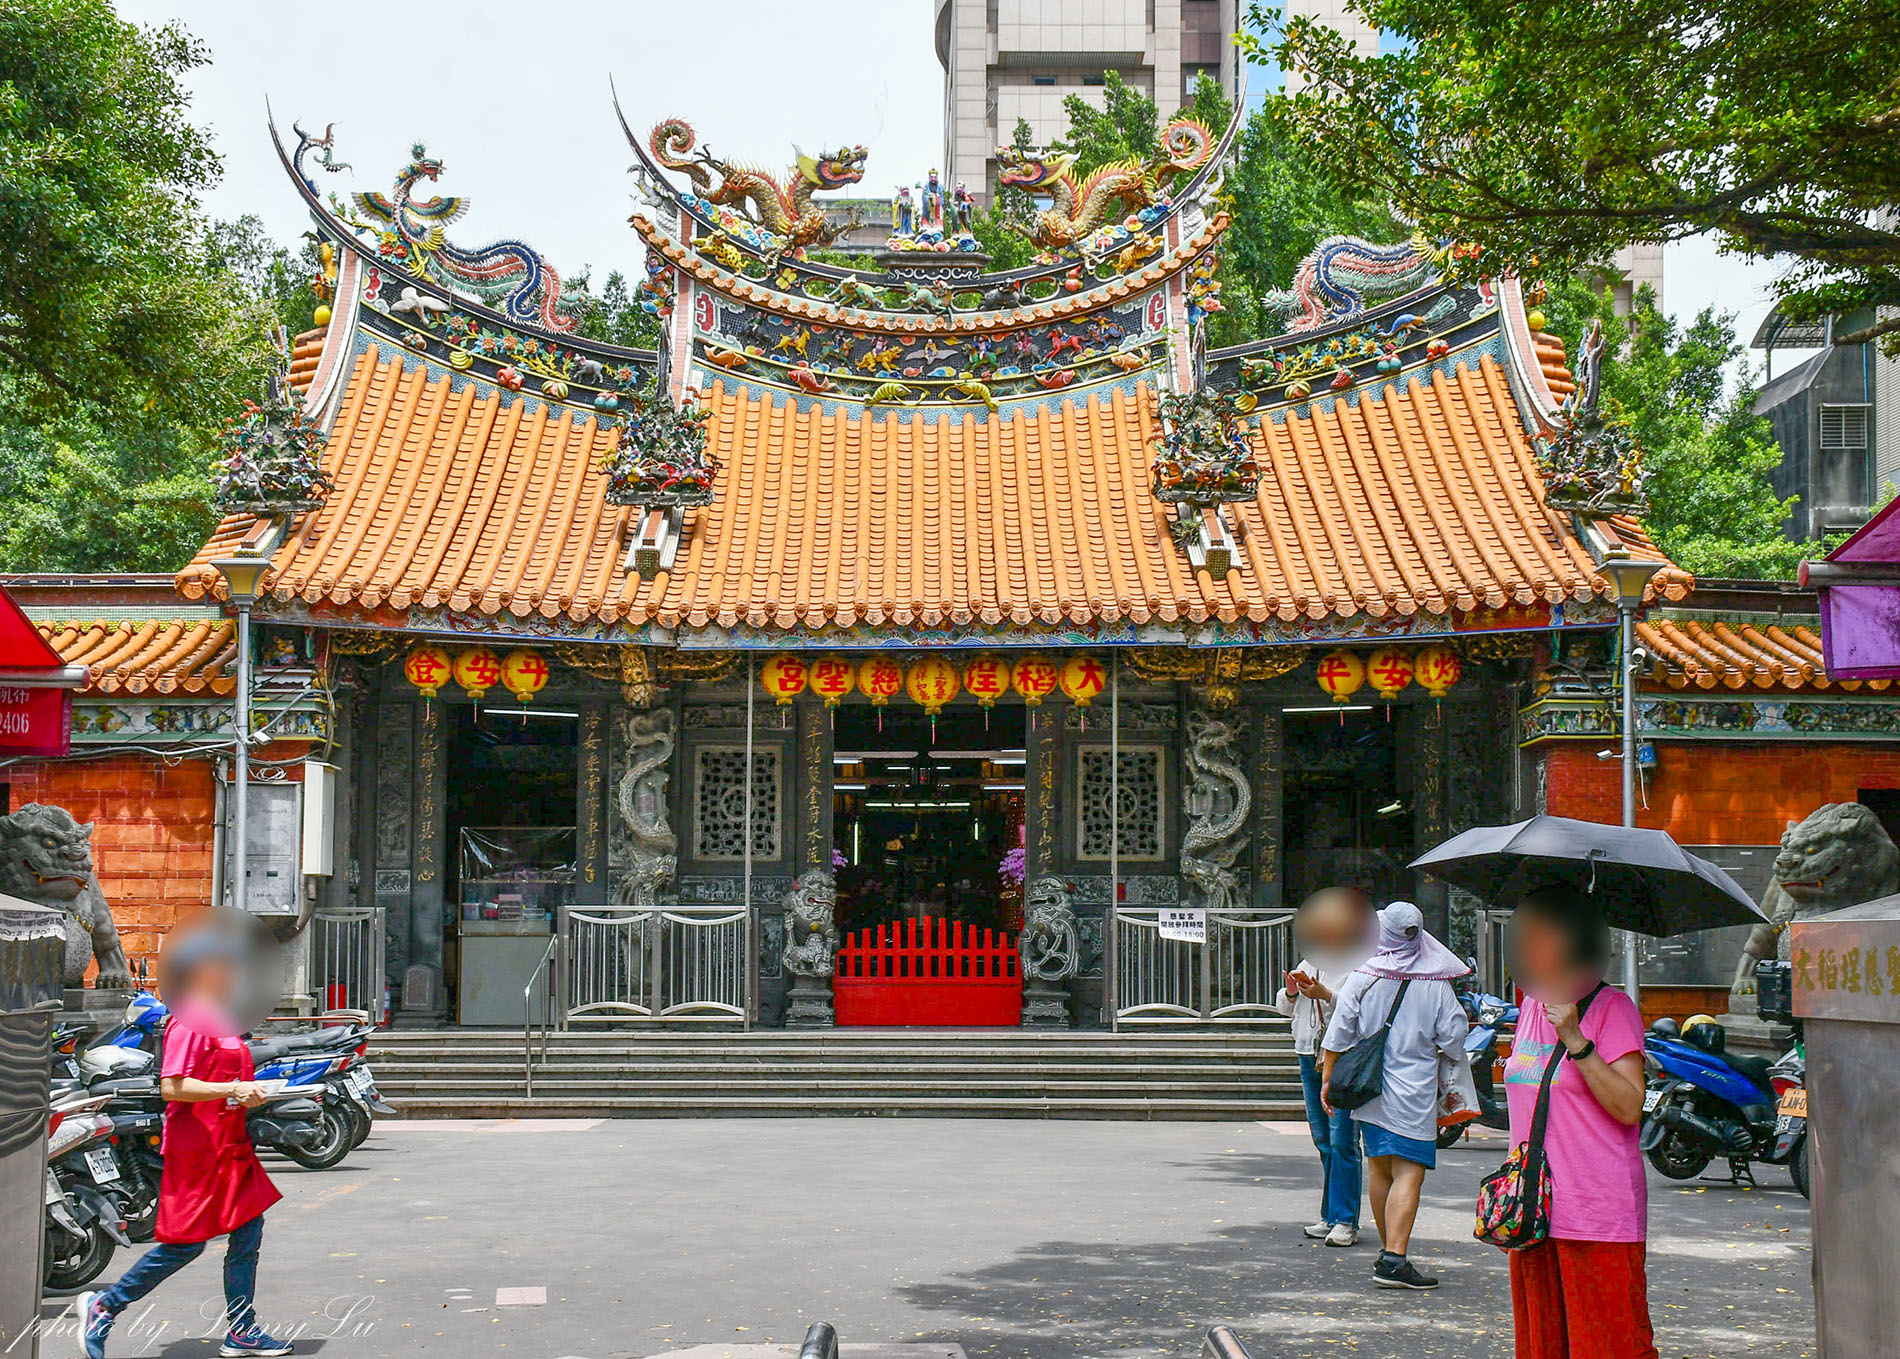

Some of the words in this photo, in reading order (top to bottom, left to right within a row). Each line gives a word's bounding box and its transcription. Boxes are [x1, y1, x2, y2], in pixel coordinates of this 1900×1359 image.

[466, 651, 500, 686] 安
[775, 657, 805, 692] 宮
[815, 661, 849, 692] 聖
[871, 661, 900, 695] 慈
[966, 660, 1000, 693] 埕
[1017, 662, 1058, 693] 稻
[1075, 659, 1104, 692] 大
[1317, 656, 1352, 690] 平
[1373, 653, 1414, 688] 安
[1169, 912, 1195, 920] 慈聖宮
